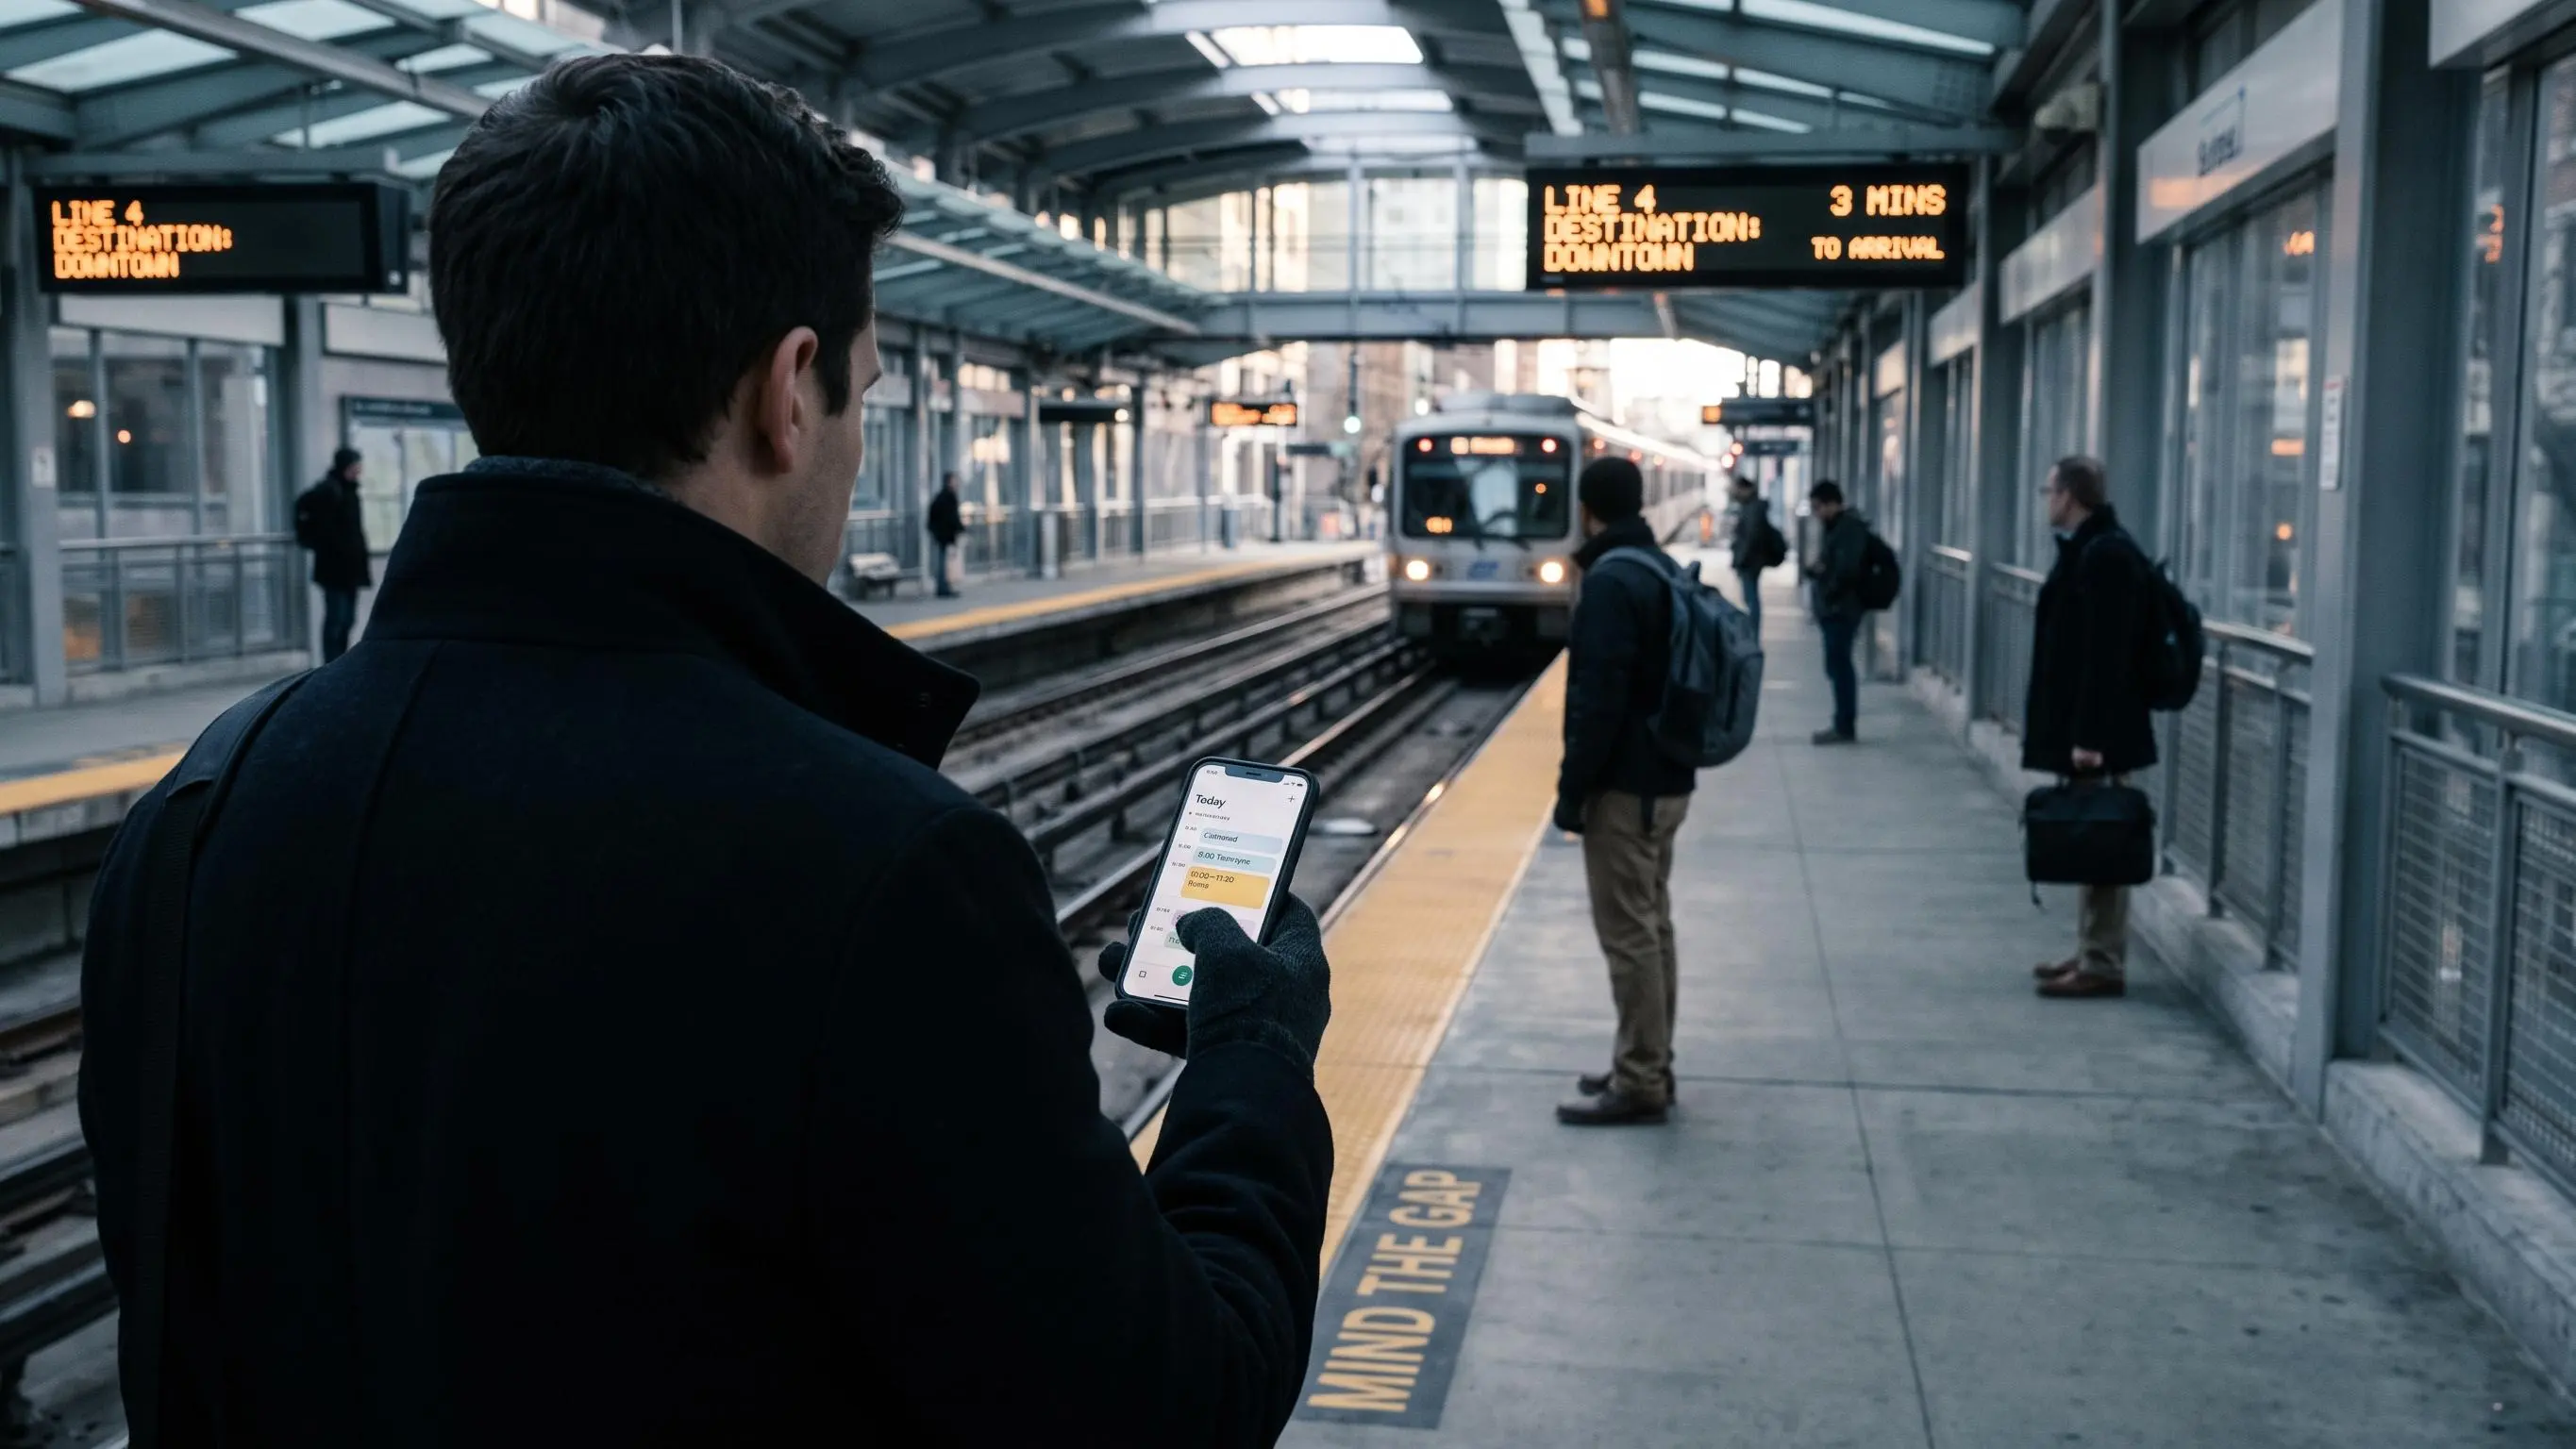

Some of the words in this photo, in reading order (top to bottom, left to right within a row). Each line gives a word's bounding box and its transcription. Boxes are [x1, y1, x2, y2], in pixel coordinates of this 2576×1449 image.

[52, 200, 116, 227] LINE
[125, 200, 144, 227] 4
[1544, 184, 1622, 215] LINE
[1633, 184, 1657, 215] 4
[1830, 184, 1854, 216] 3
[1865, 184, 1948, 216] MINS
[53, 224, 233, 253] DESTINATION:
[1544, 212, 1762, 244] DESTINATION:
[1544, 242, 1695, 273] DOWNTOWN
[1811, 235, 1843, 260] TO
[1848, 235, 1947, 260] ARRIVAL
[54, 251, 180, 279] DOWNTOWN
[1196, 793, 1227, 809] Today
[1388, 1169, 1482, 1228] GAP
[1356, 1233, 1464, 1295] THE
[1306, 1306, 1436, 1412] MIND
